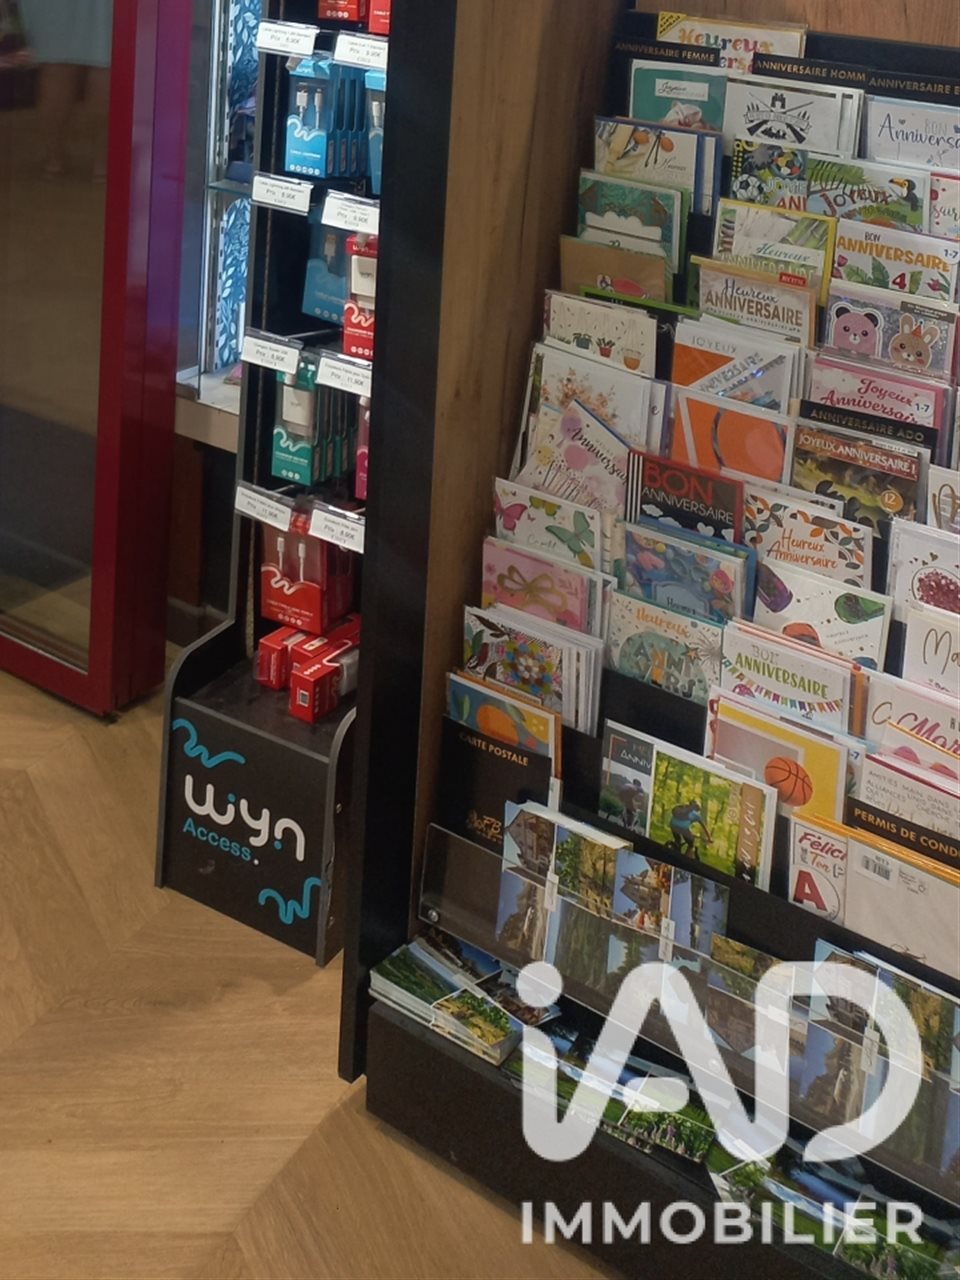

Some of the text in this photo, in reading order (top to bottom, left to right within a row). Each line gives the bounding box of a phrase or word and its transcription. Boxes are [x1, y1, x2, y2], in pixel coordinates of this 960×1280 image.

[615, 42, 715, 63] ANNIVERSAIRE FEMME
[678, 27, 774, 54] Heureux
[755, 59, 868, 82] ANNIVERSAIRE HOMM
[869, 77, 951, 94] ANNIVERSAIRE
[819, 186, 891, 218] JOYEUX
[864, 231, 881, 242] BON
[755, 242, 811, 263] Heureux
[837, 235, 951, 273] ANNIVERSAIRE
[721, 278, 780, 304] Heureux
[891, 272, 907, 290] 4
[705, 290, 803, 327] ANNIVERSAIRE
[691, 335, 738, 353] JOYEUX
[820, 390, 918, 424] Anniversair
[858, 378, 913, 407] Joyeux
[810, 408, 925, 442] ANNIVERSAIRE ADO
[799, 434, 836, 451] JOYEUX
[838, 444, 912, 473] ANNIVERSAIRE
[643, 464, 713, 505] BON
[884, 493, 896, 505] 12
[641, 487, 734, 523] ANNIVERSAIRE
[781, 527, 825, 552] Heureux
[766, 540, 838, 570] Anniversaire
[636, 607, 691, 639] Heureux
[752, 644, 780, 660] BON
[735, 653, 830, 700] ANNIVERSAIRE
[458, 730, 529, 767] CARTE POSTALE
[849, 749, 860, 760] -7
[853, 806, 960, 858] PERMIS DE COND
[793, 869, 828, 912] A
